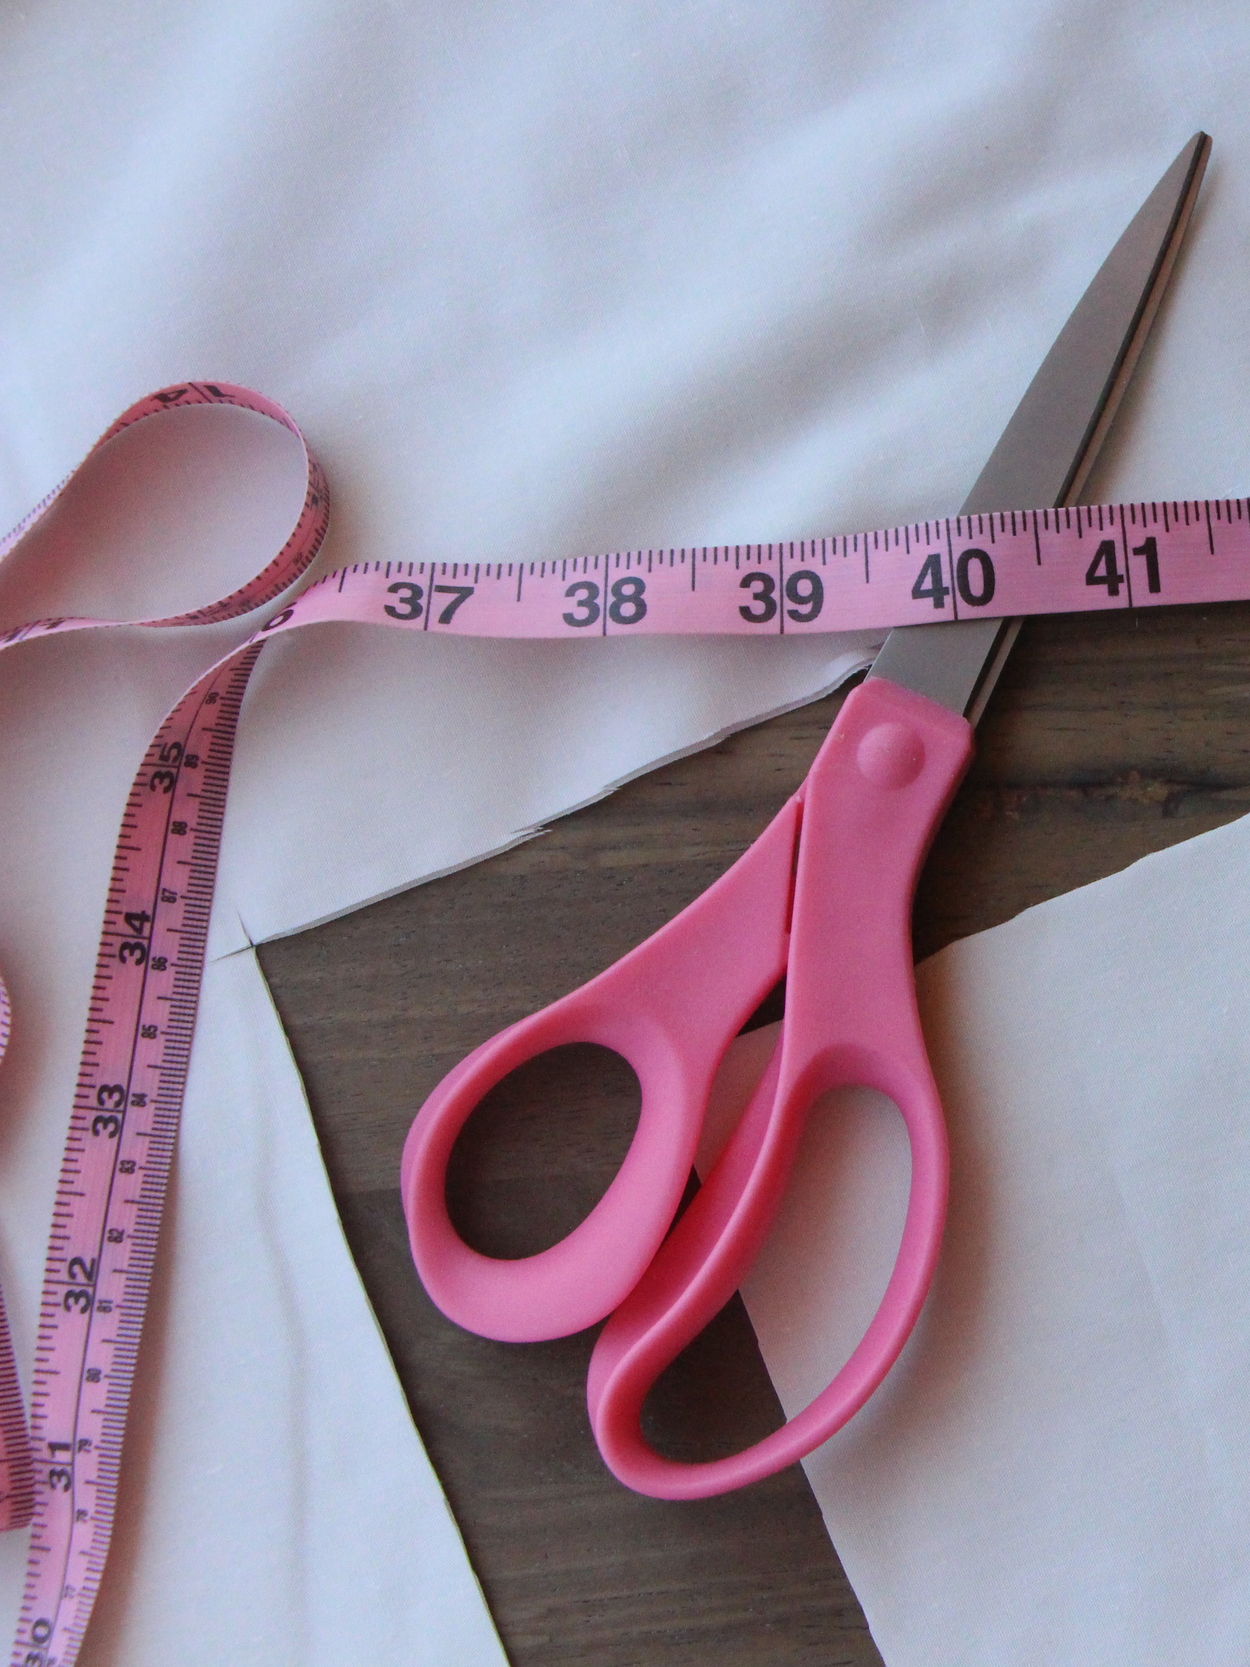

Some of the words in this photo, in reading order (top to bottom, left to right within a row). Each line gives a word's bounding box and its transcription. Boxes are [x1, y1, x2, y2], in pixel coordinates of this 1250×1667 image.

[384, 581, 475, 625] 37
[562, 576, 648, 628] 38
[738, 569, 825, 624] 39
[911, 548, 996, 610] 40
[1085, 536, 1162, 597] 41
[47, 1440, 74, 1493] 31
[63, 1256, 97, 1315] 32
[91, 1084, 126, 1139] 33
[118, 909, 151, 967] 34
[149, 741, 183, 794] 35
[107, 1227, 125, 1244] 82
[119, 1159, 137, 1175] 83
[130, 1092, 148, 1108] 84
[141, 1024, 158, 1040] 85
[150, 956, 168, 972] 86
[161, 888, 178, 904] 87
[183, 754, 200, 769] 89
